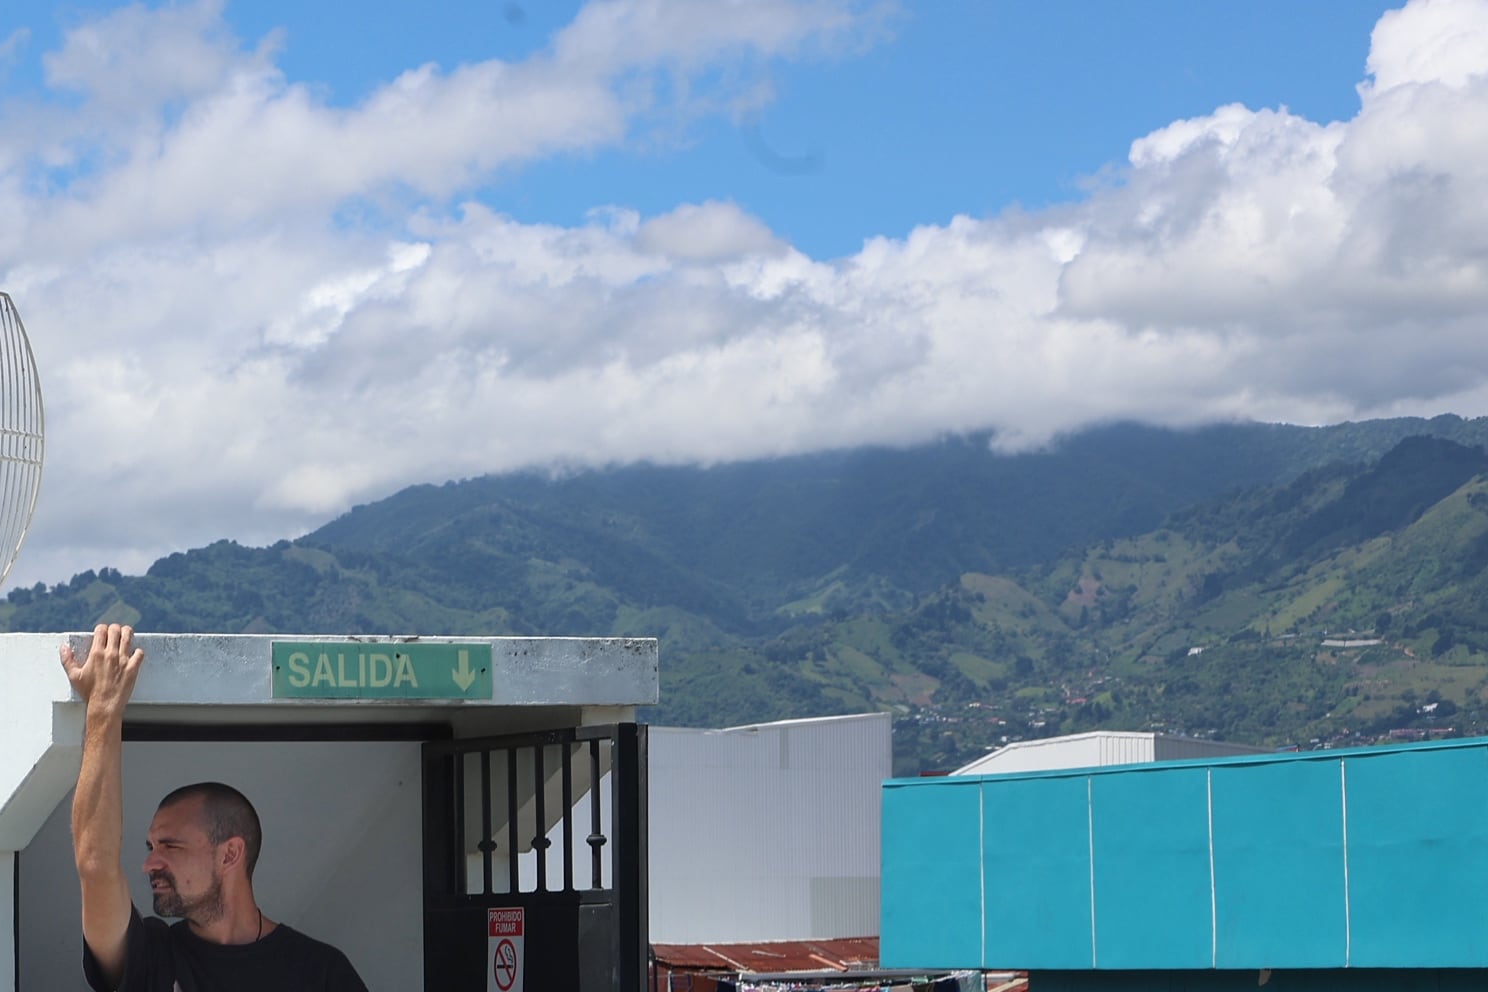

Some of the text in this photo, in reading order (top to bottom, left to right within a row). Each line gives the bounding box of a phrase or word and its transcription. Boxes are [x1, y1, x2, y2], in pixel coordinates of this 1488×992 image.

[288, 652, 418, 688] SALIDA
[489, 910, 521, 922] PROHIBIDO
[495, 923, 516, 933] FUMAR
